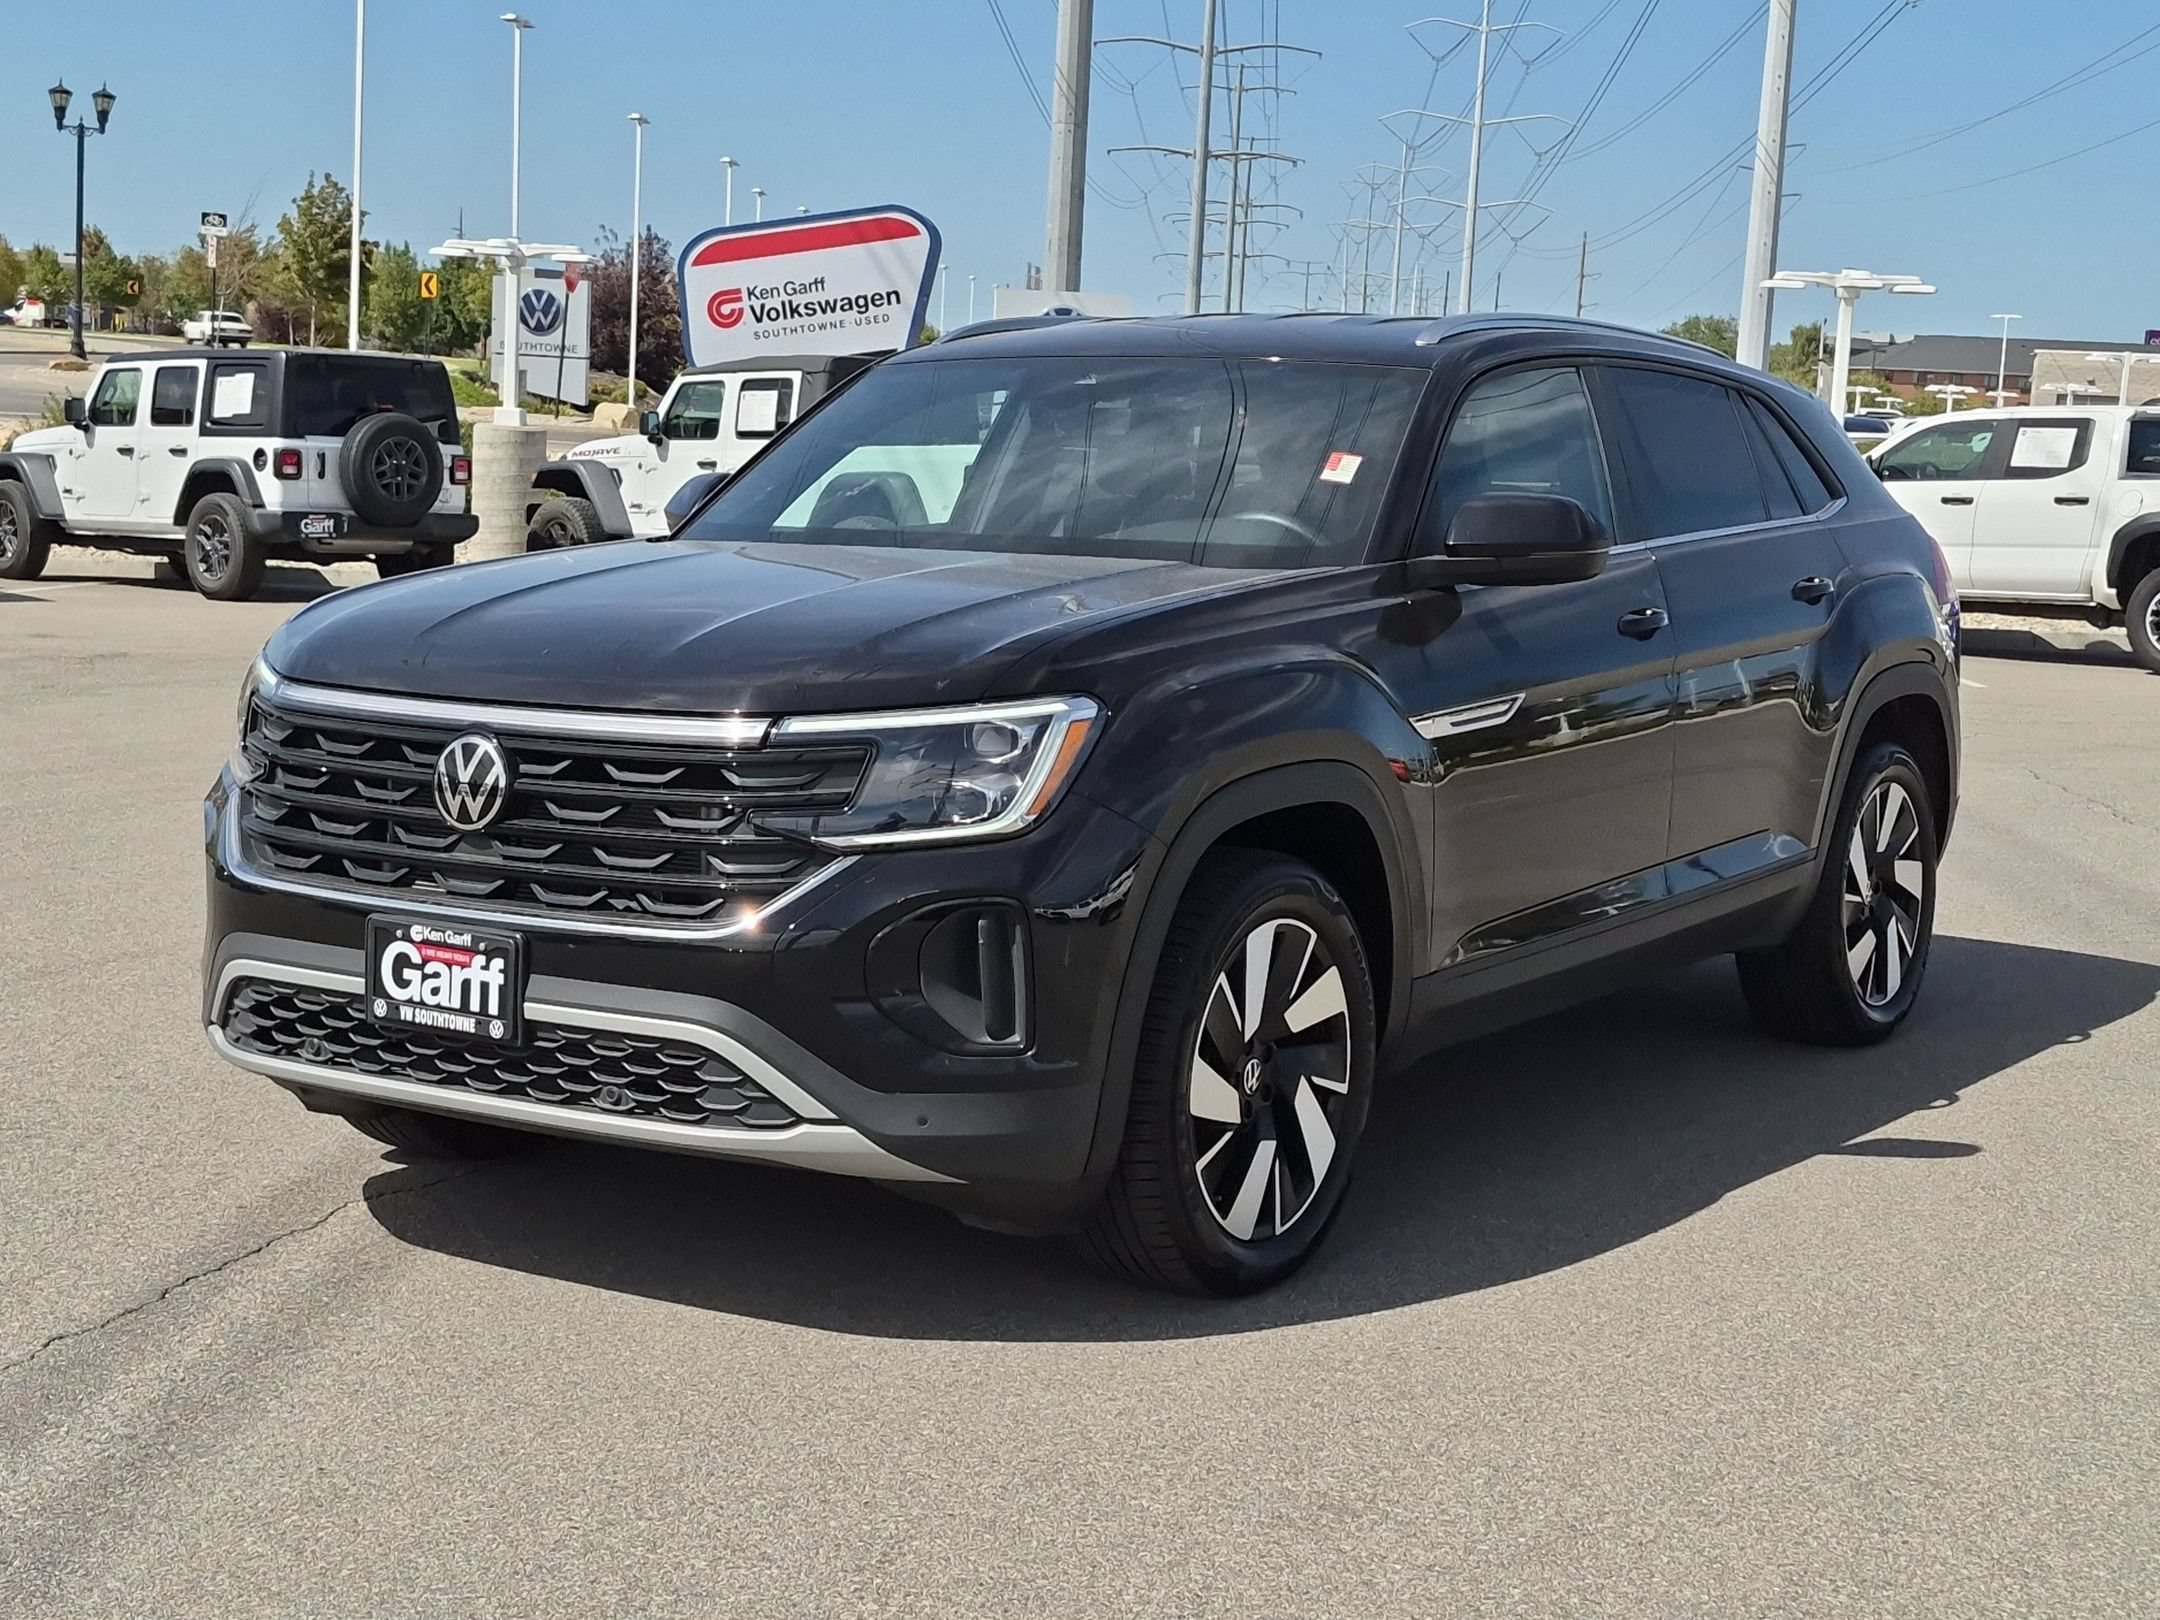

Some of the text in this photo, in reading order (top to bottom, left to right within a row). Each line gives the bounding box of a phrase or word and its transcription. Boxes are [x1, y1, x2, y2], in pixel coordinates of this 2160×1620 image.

[746, 276, 826, 302] Ken Garff
[749, 289, 901, 324] Volkswagen
[753, 313, 890, 341] SOUTHTOWNE USED
[500, 340, 579, 354] STHTOWNE
[571, 446, 622, 458] MOJAVE
[300, 518, 334, 533] Garff
[423, 926, 472, 947] Ken Garff
[381, 940, 505, 1016] Garff
[399, 1004, 476, 1034] VW SOUTHTOWNE
